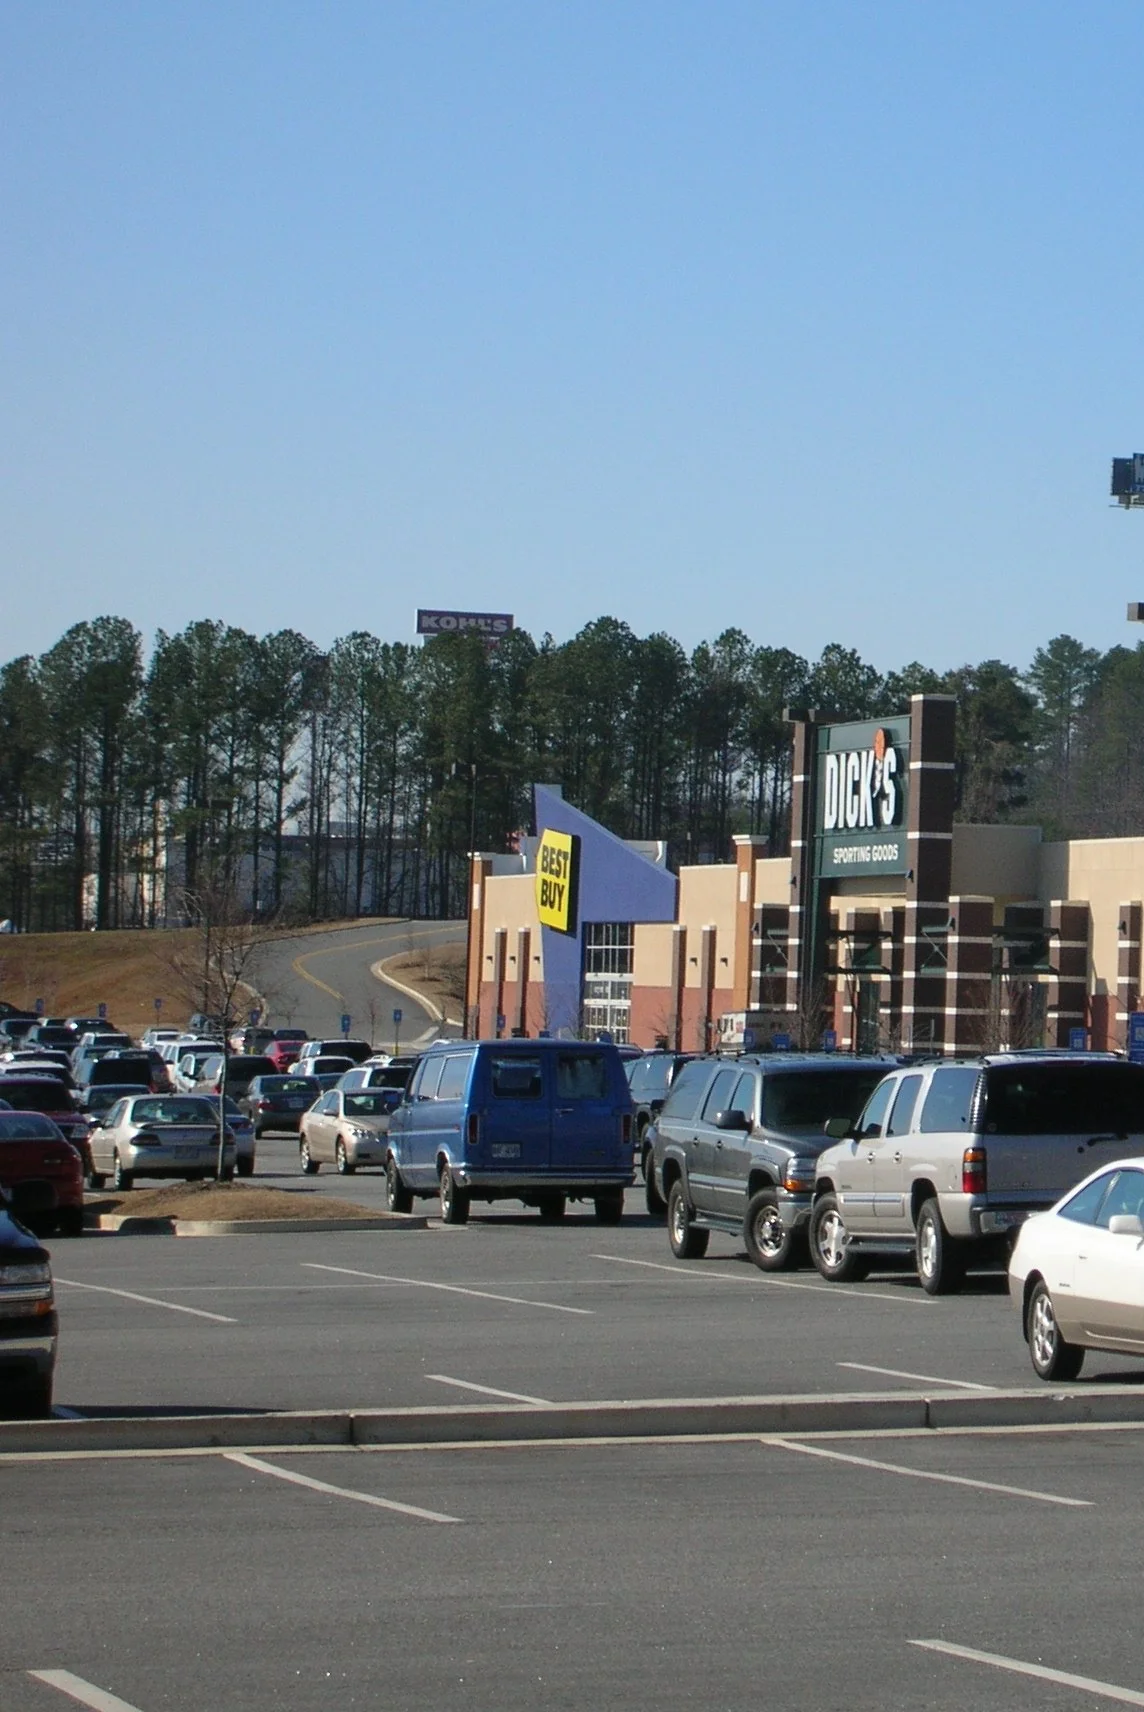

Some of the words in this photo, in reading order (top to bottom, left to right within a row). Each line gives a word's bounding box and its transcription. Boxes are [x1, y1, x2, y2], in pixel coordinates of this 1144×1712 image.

[825, 745, 898, 829] DICK'S
[541, 845, 569, 879] BEST
[833, 847, 871, 863] SPORTING
[872, 844, 899, 861] GOODS
[540, 879, 565, 912] BUY
